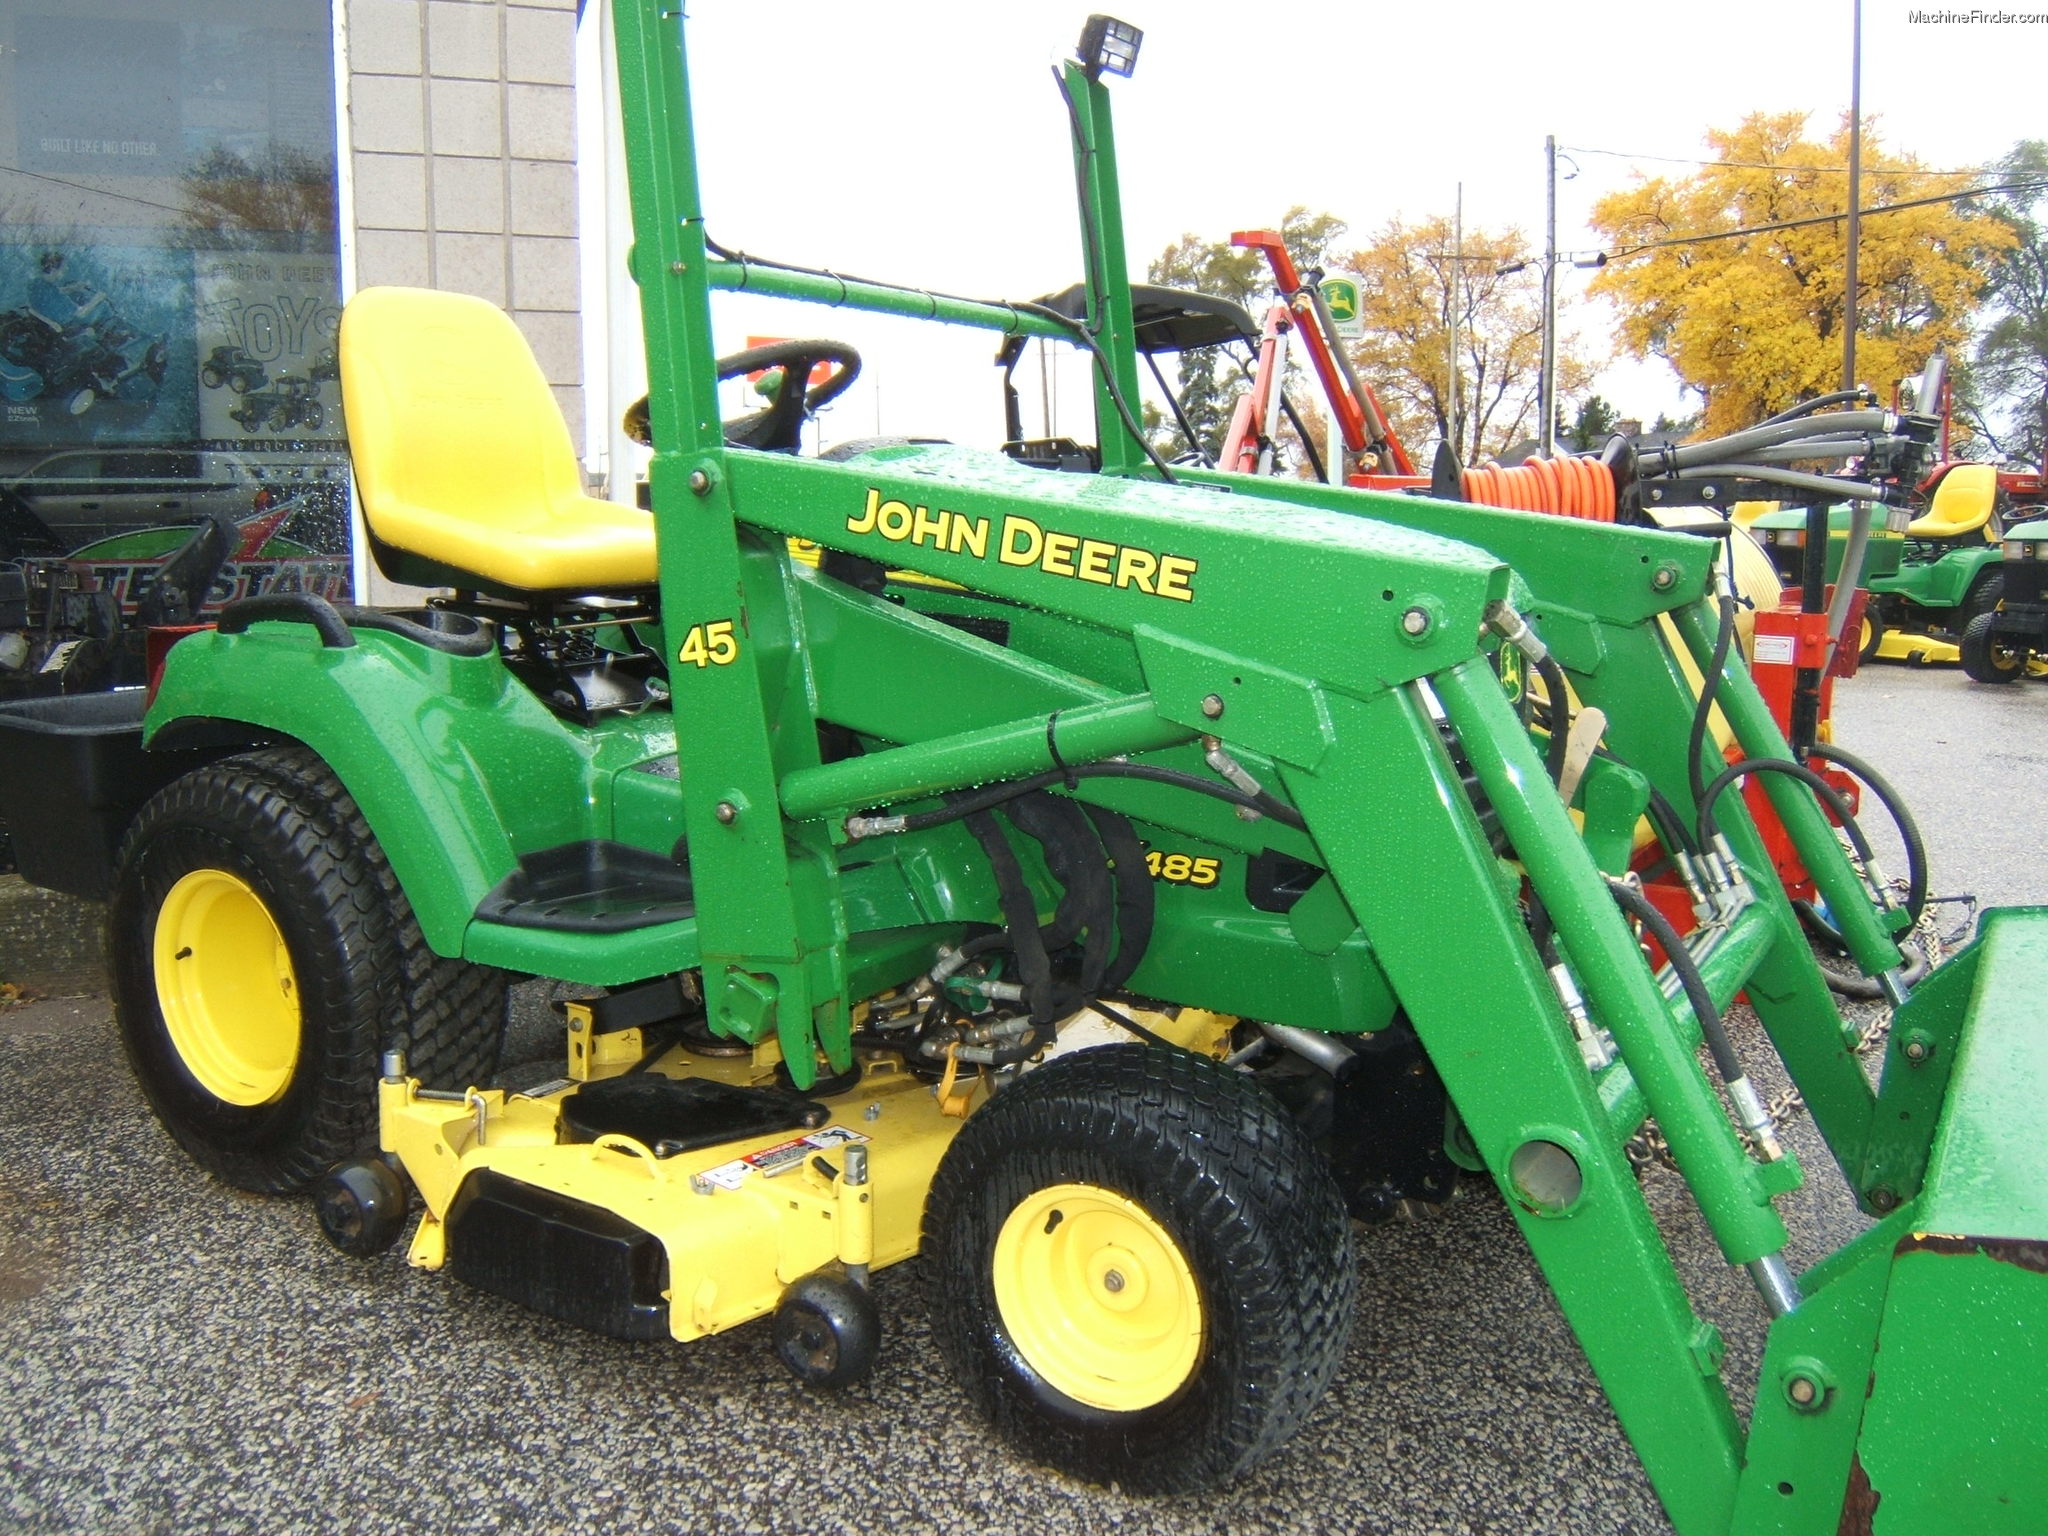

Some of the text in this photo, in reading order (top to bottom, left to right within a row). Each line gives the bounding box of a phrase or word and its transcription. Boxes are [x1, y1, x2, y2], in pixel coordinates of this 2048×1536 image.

[40, 137, 71, 153] BUILT
[74, 138, 100, 154] LIKE
[102, 139, 119, 155] NO
[282, 265, 340, 283] DEER
[7, 406, 38, 415] NEW
[845, 487, 1198, 603] JOHN DEERE
[678, 617, 737, 669] 45
